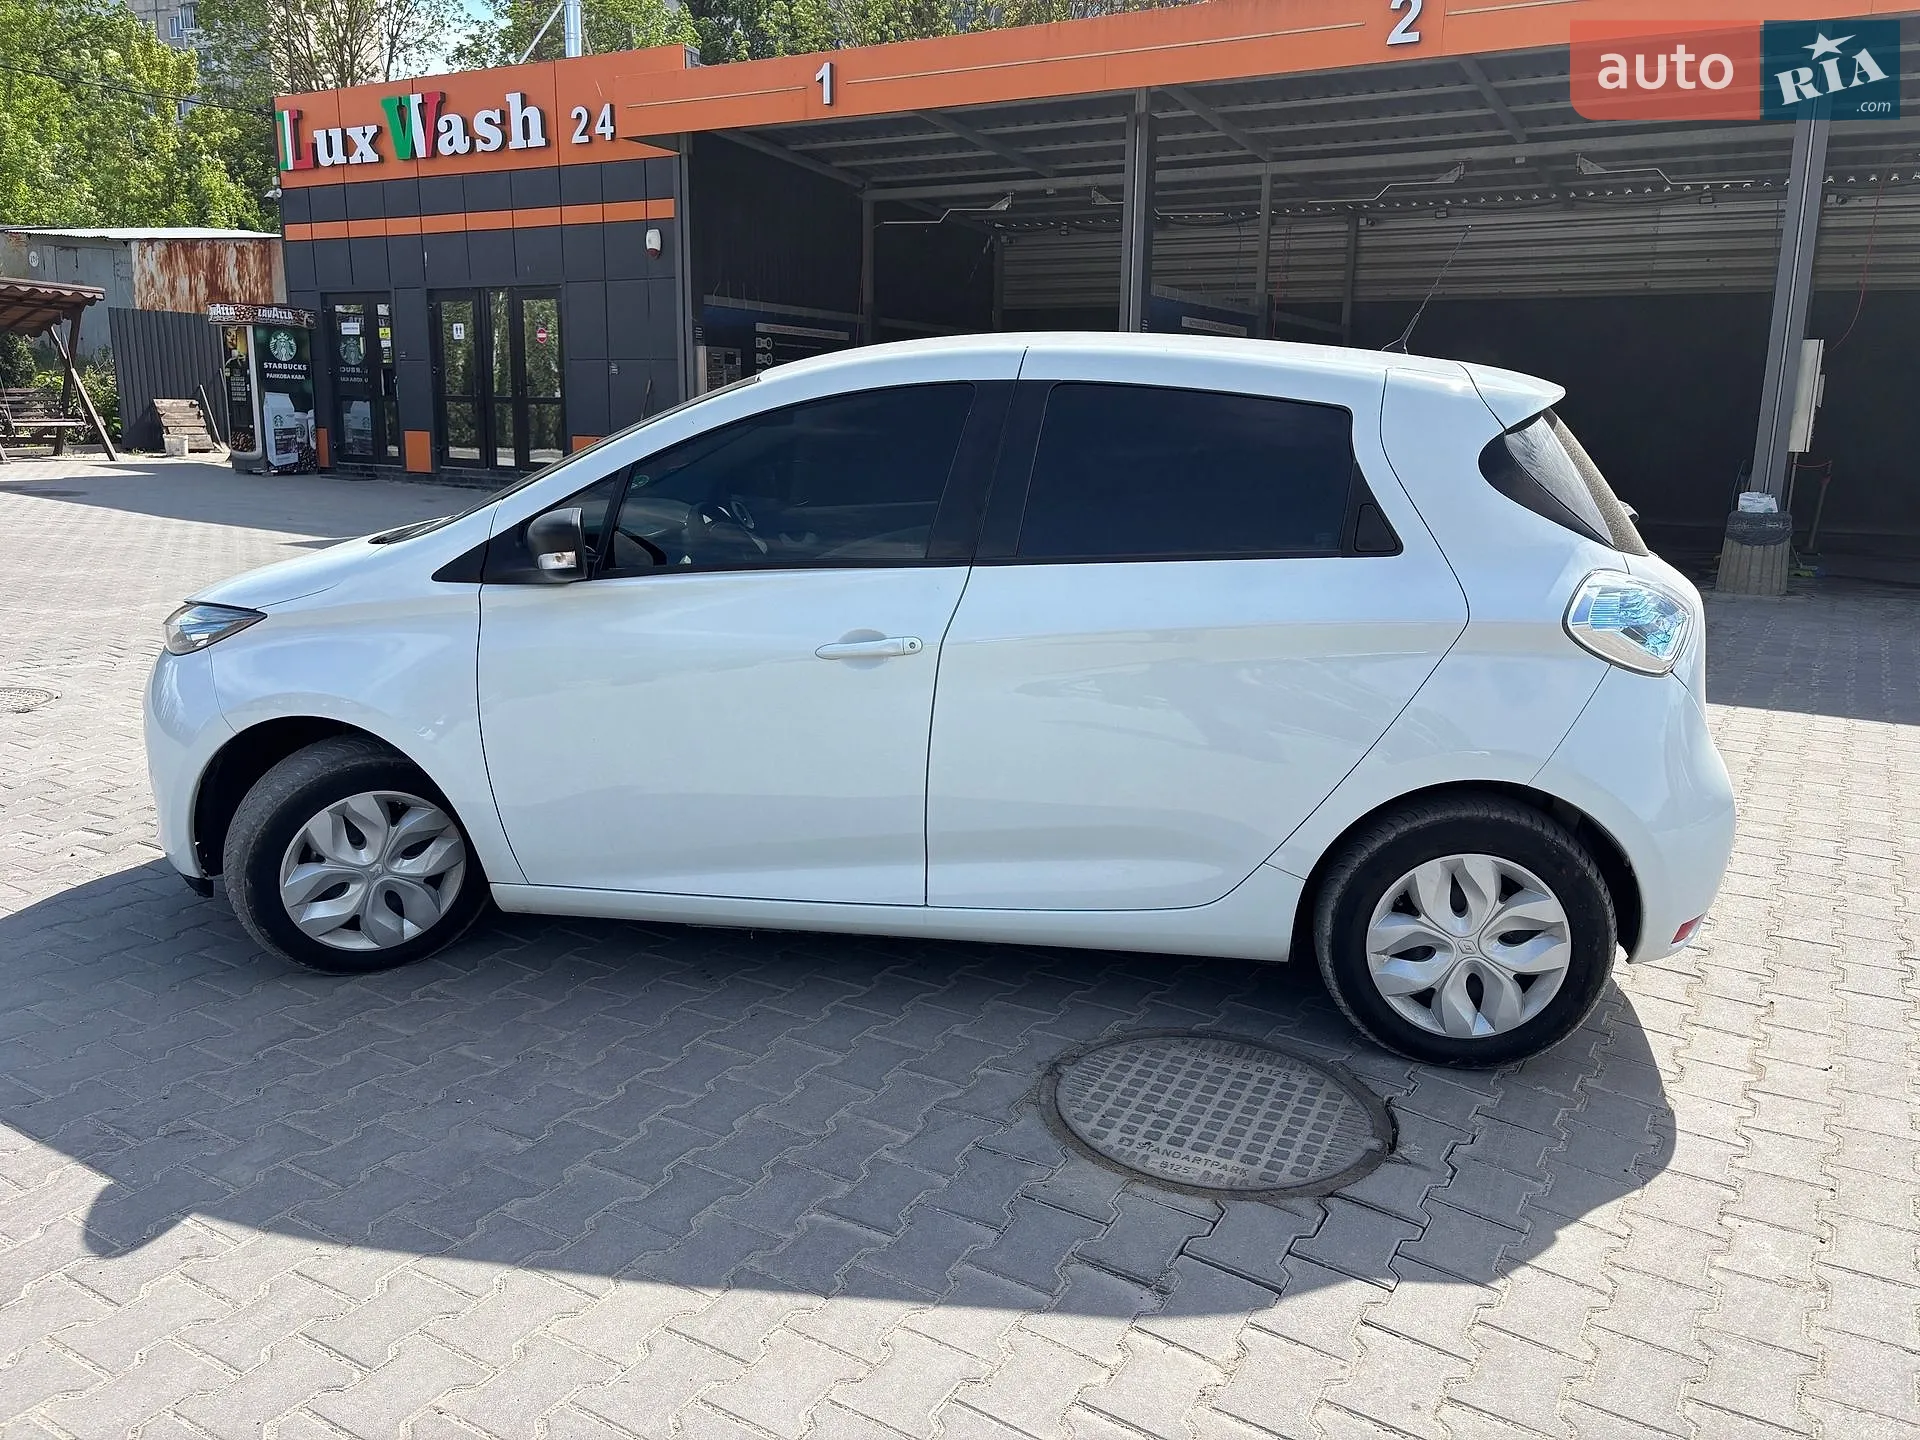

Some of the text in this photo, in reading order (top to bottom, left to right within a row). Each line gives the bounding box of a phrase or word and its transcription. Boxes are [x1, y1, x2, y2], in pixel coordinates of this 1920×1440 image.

[1387, 0, 1422, 45] 2
[815, 62, 832, 105] 1
[571, 103, 616, 145] 24
[263, 362, 307, 371] STARBUCKS
